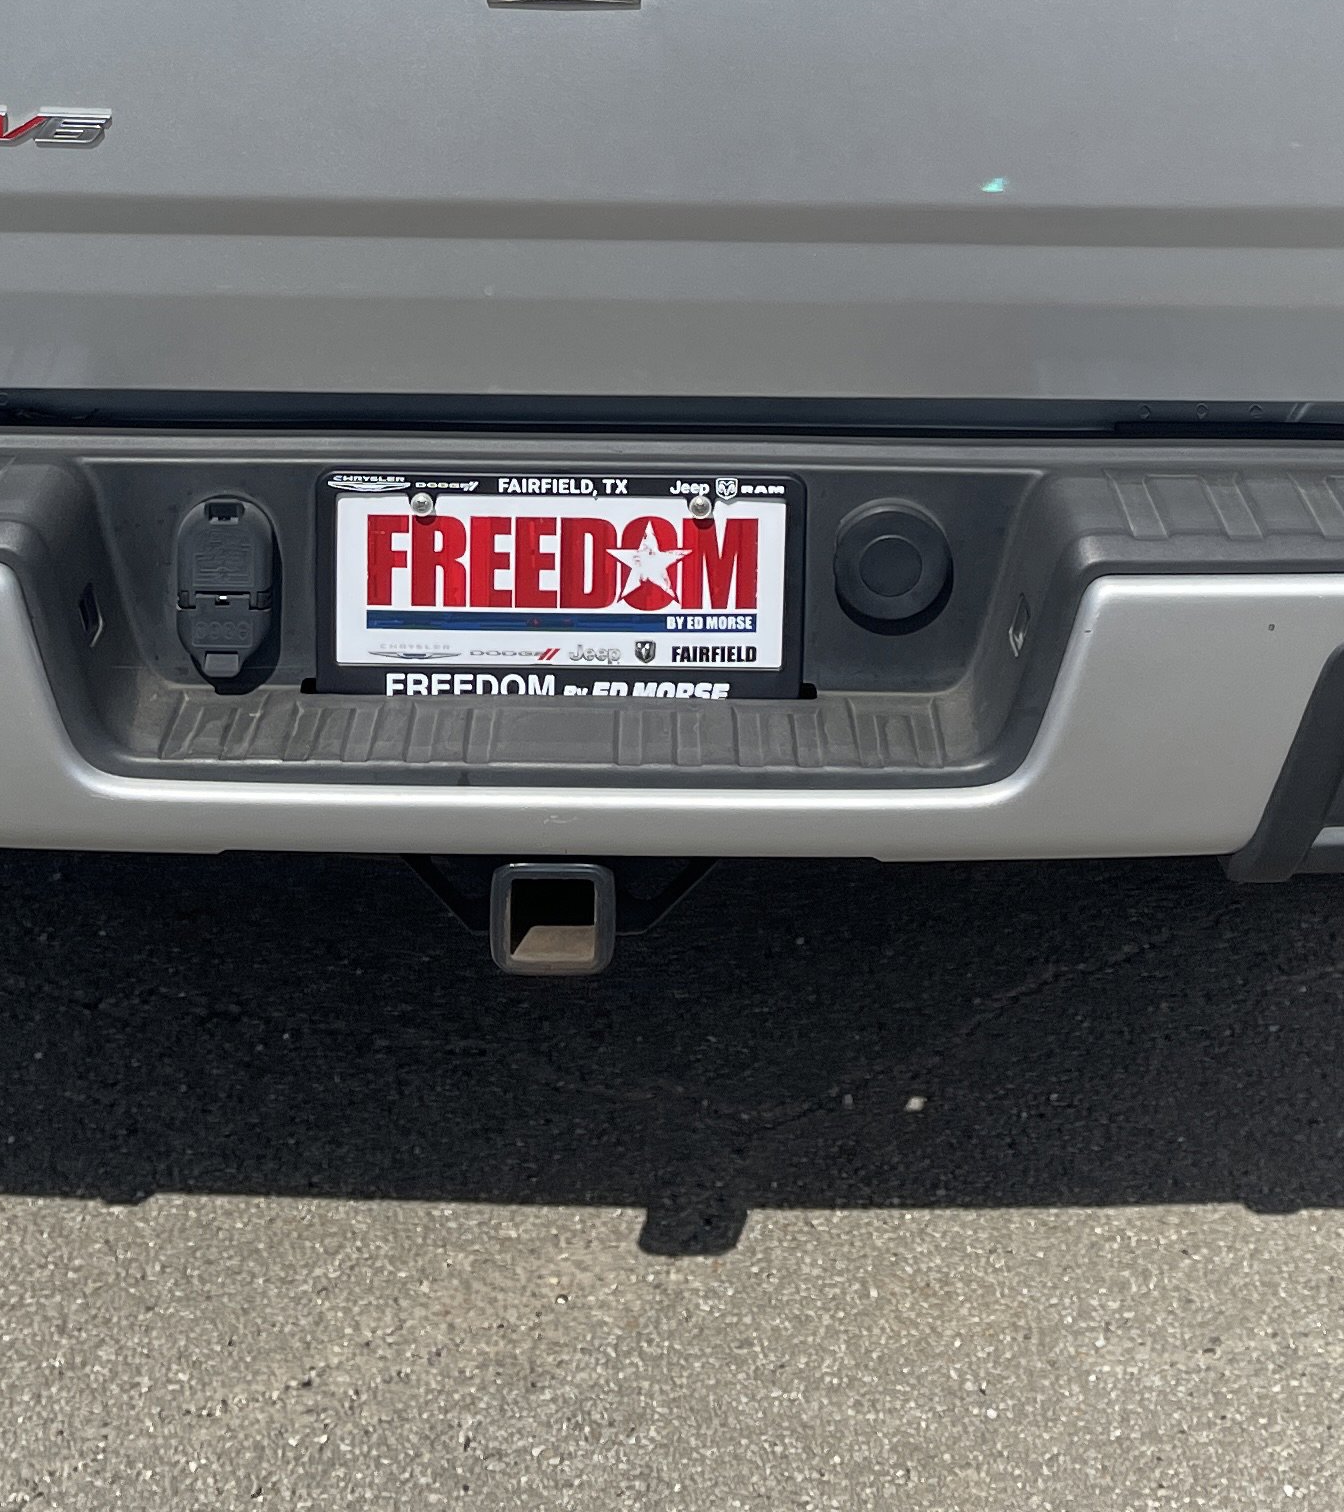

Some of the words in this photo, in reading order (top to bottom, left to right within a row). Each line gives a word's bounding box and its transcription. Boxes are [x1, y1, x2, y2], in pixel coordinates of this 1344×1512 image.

[498, 478, 598, 497] FAIRFIELD,
[602, 478, 628, 494] TX
[669, 480, 710, 496] Jeep
[740, 485, 785, 494] RAM
[366, 514, 758, 611] FREEDOM
[666, 616, 684, 630] BY
[687, 616, 704, 630] ED
[706, 616, 753, 630] MORSE
[569, 644, 622, 665] Jeep
[671, 646, 757, 662] FAIRFIELD
[386, 673, 555, 697] FREEDOM
